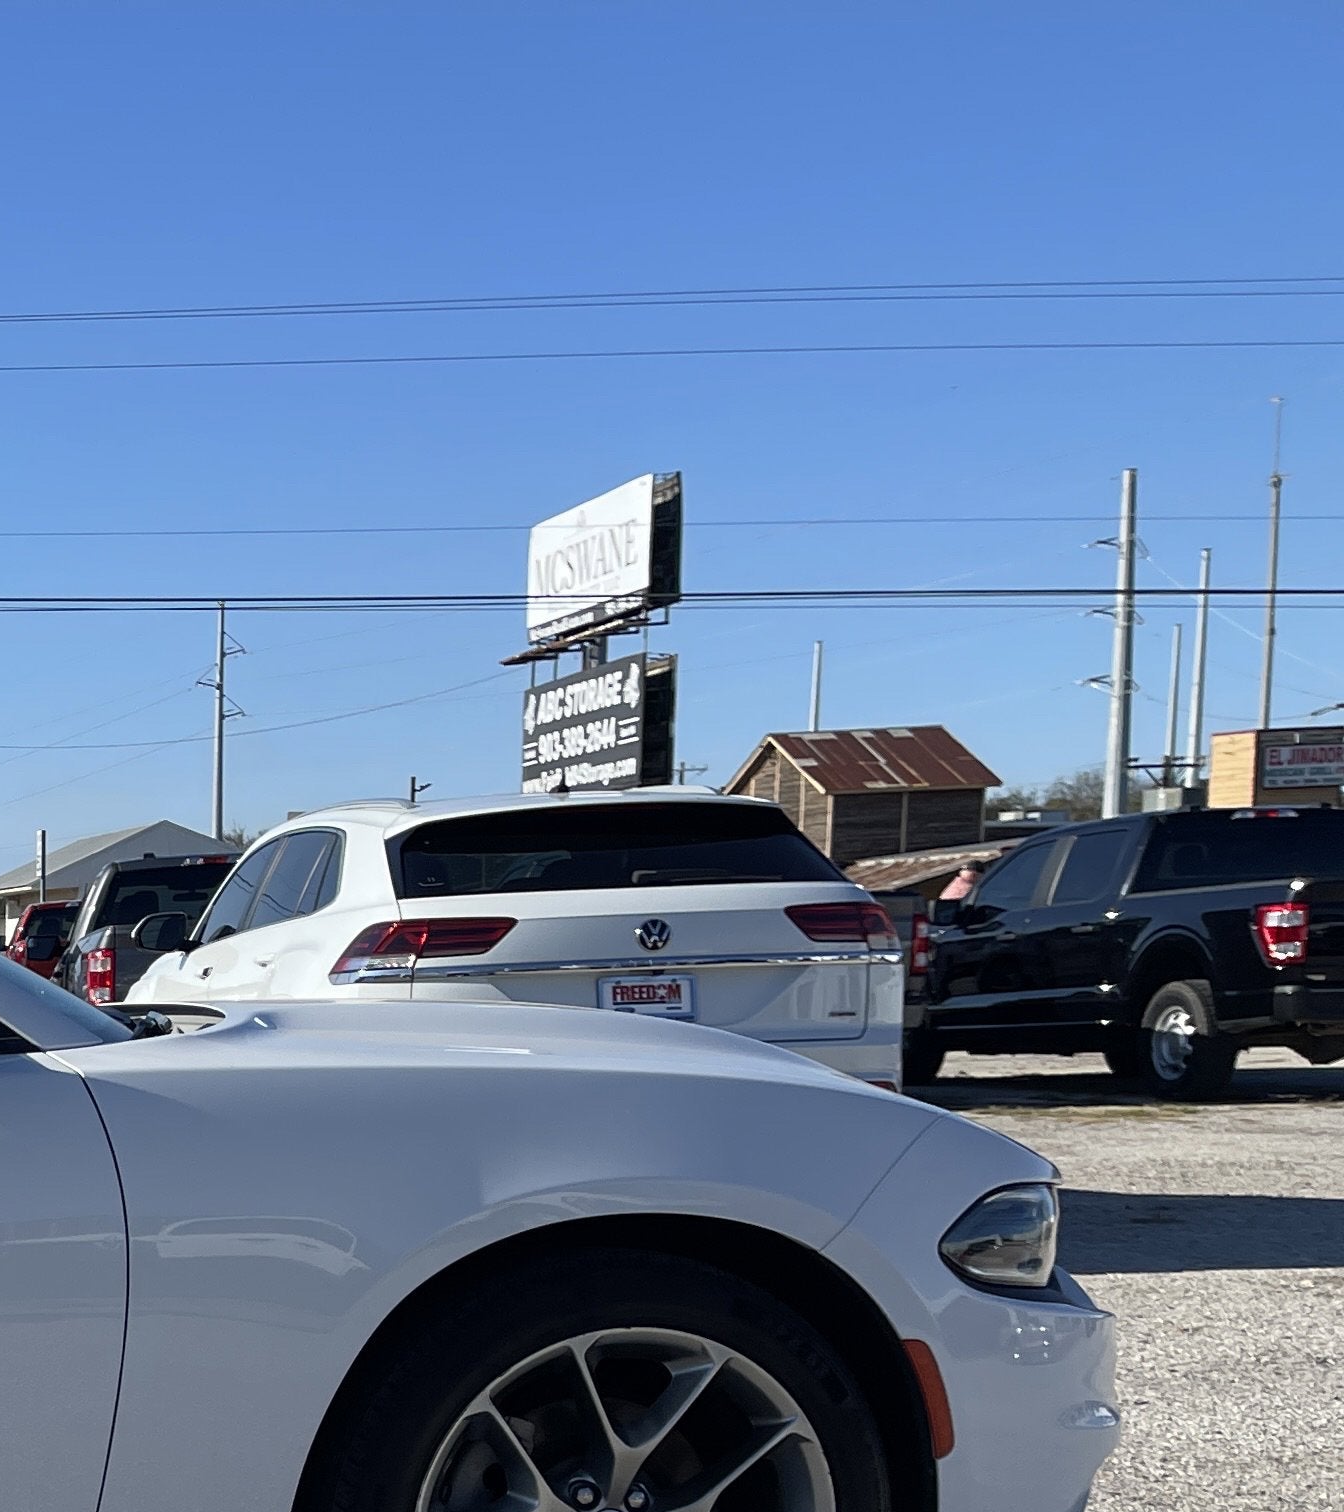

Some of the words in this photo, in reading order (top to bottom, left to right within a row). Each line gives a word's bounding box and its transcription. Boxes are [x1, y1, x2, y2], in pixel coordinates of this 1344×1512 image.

[536, 687, 564, 725] ABC
[564, 671, 623, 718] STORAGE
[1268, 749, 1284, 766] EL
